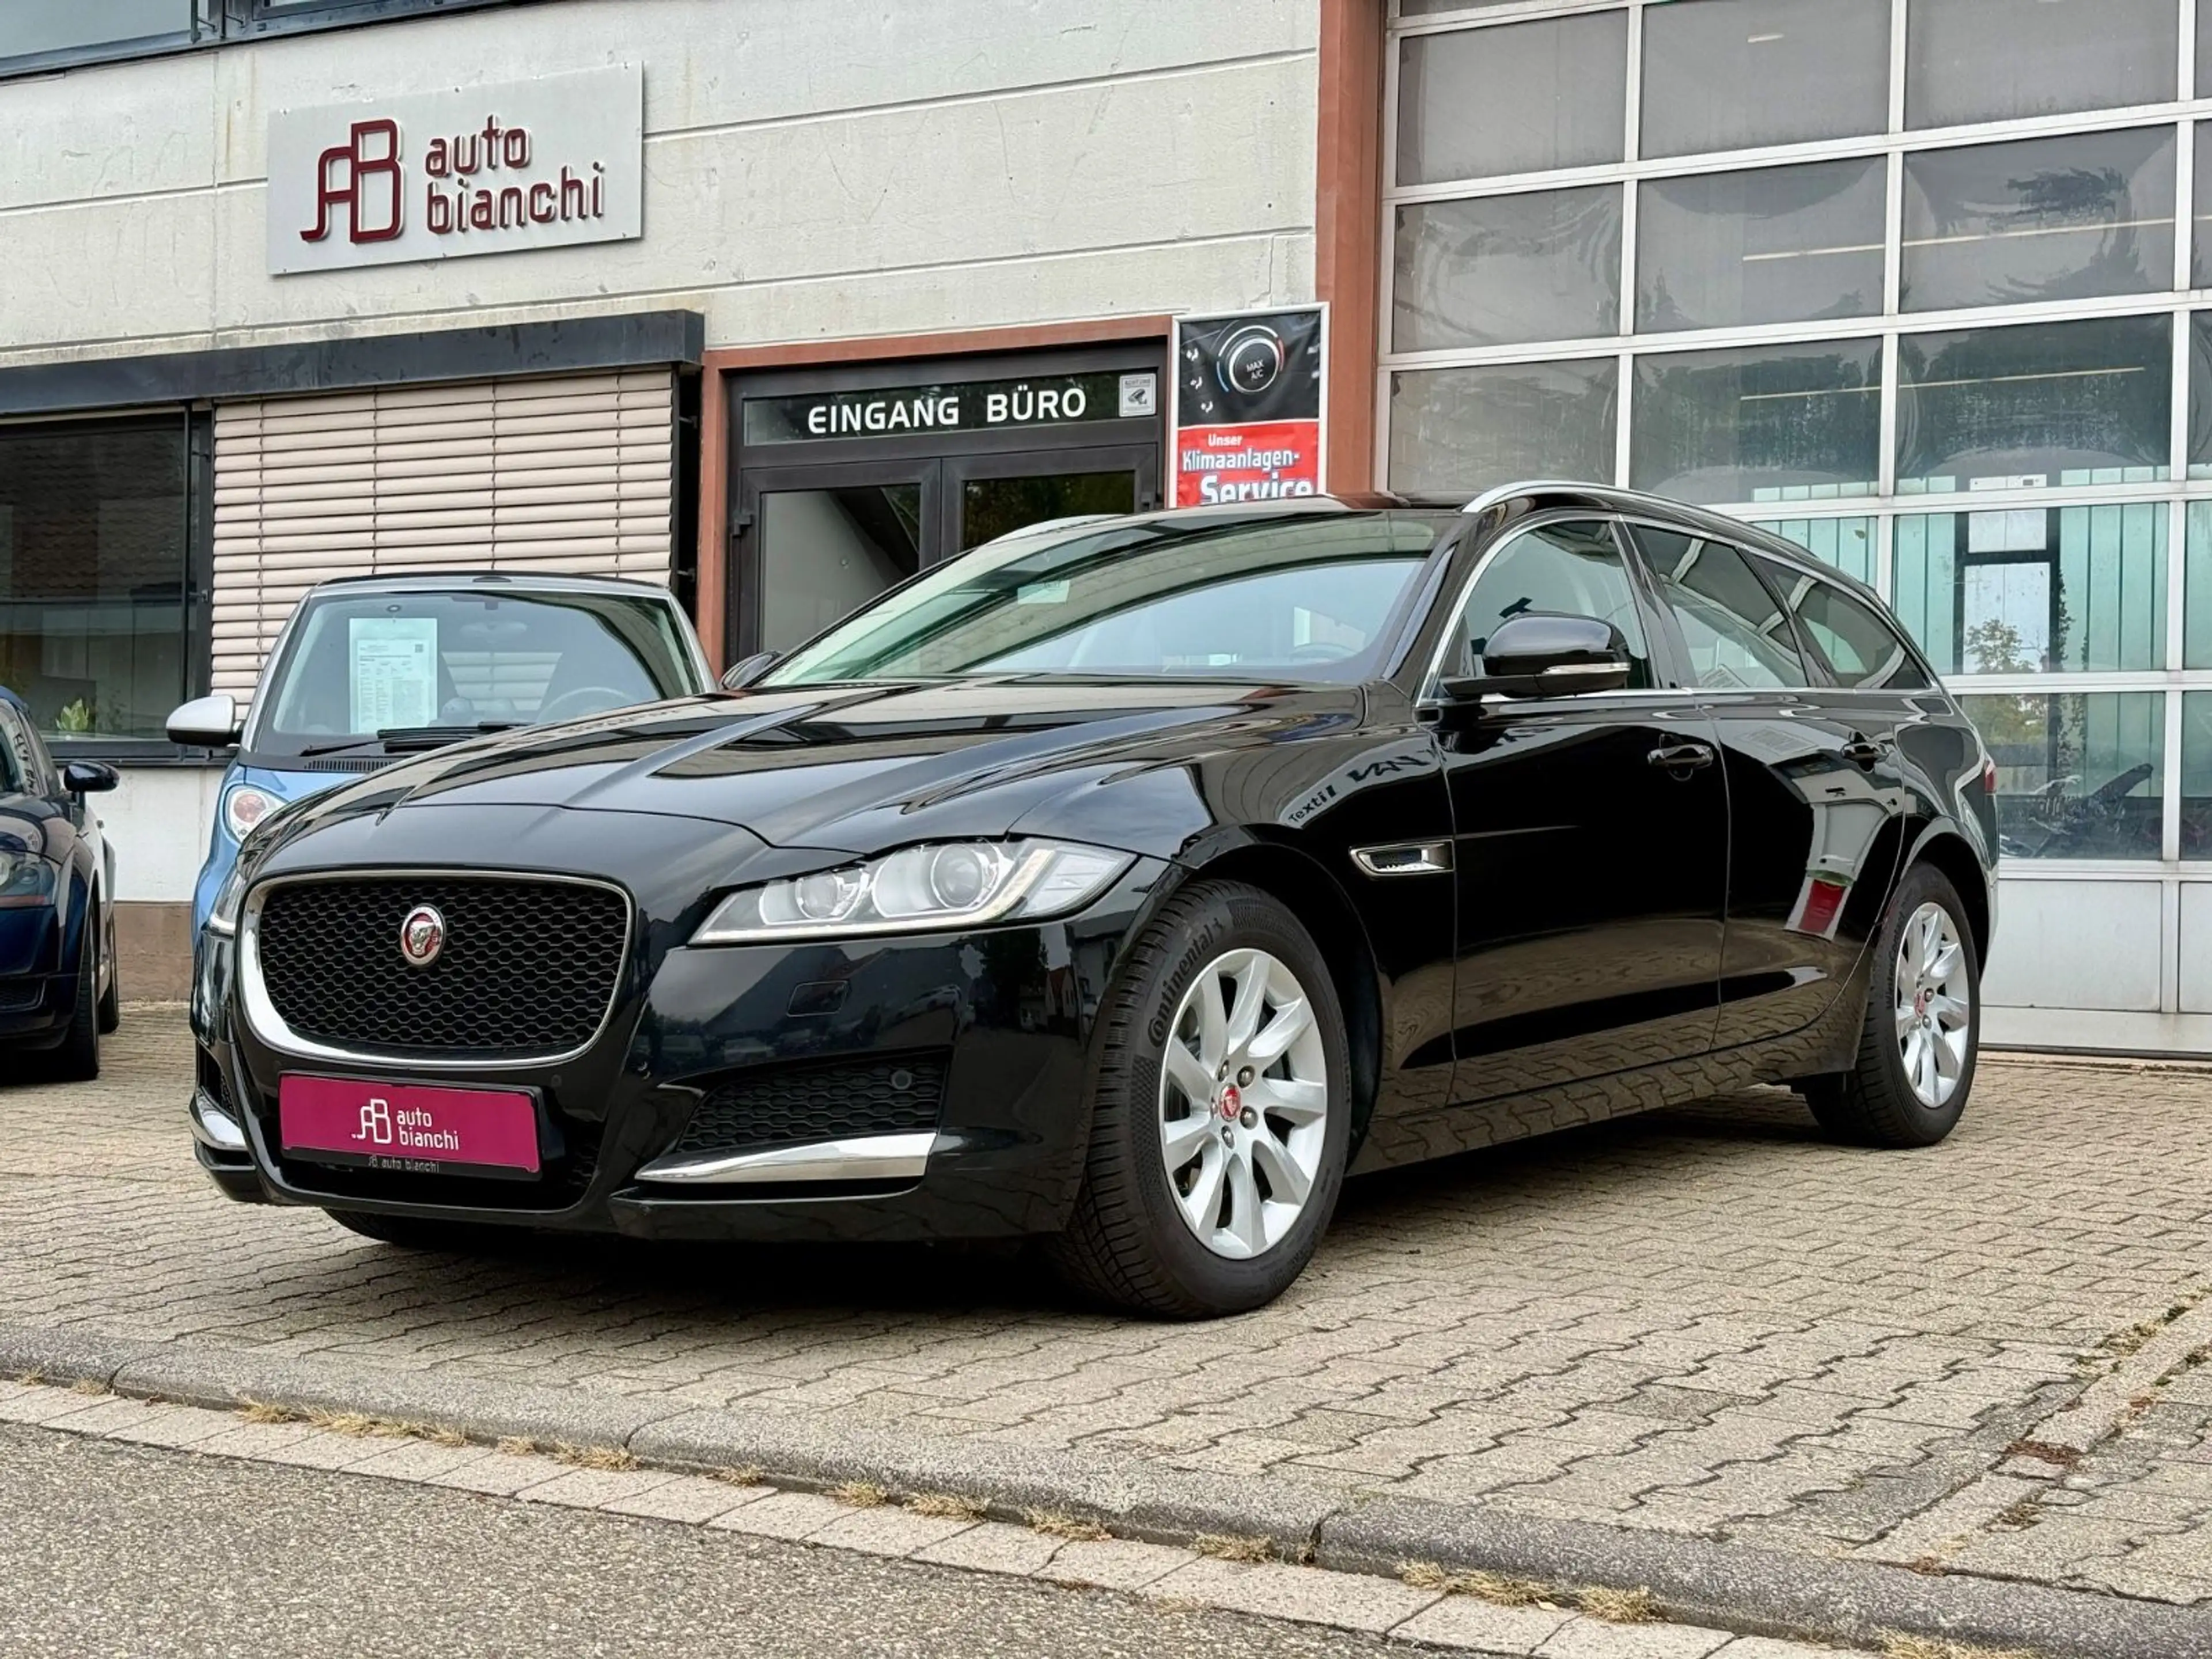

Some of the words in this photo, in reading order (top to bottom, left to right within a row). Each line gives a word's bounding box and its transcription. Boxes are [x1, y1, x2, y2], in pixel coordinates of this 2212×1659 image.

[425, 115, 529, 176] auto
[426, 161, 604, 234] bianchi
[1247, 359, 1264, 373] MAX
[808, 396, 959, 434] EINGANG
[987, 384, 1086, 423] BÜRO
[1208, 434, 1242, 447] Unser
[1183, 448, 1300, 471] Klimaanlagen-
[1201, 473, 1312, 503] Service
[1288, 785, 1336, 822] Textil
[1147, 924, 1215, 1048] Continental
[396, 1107, 432, 1127] auto
[398, 1127, 459, 1151] bianchi
[381, 1157, 402, 1170] auto
